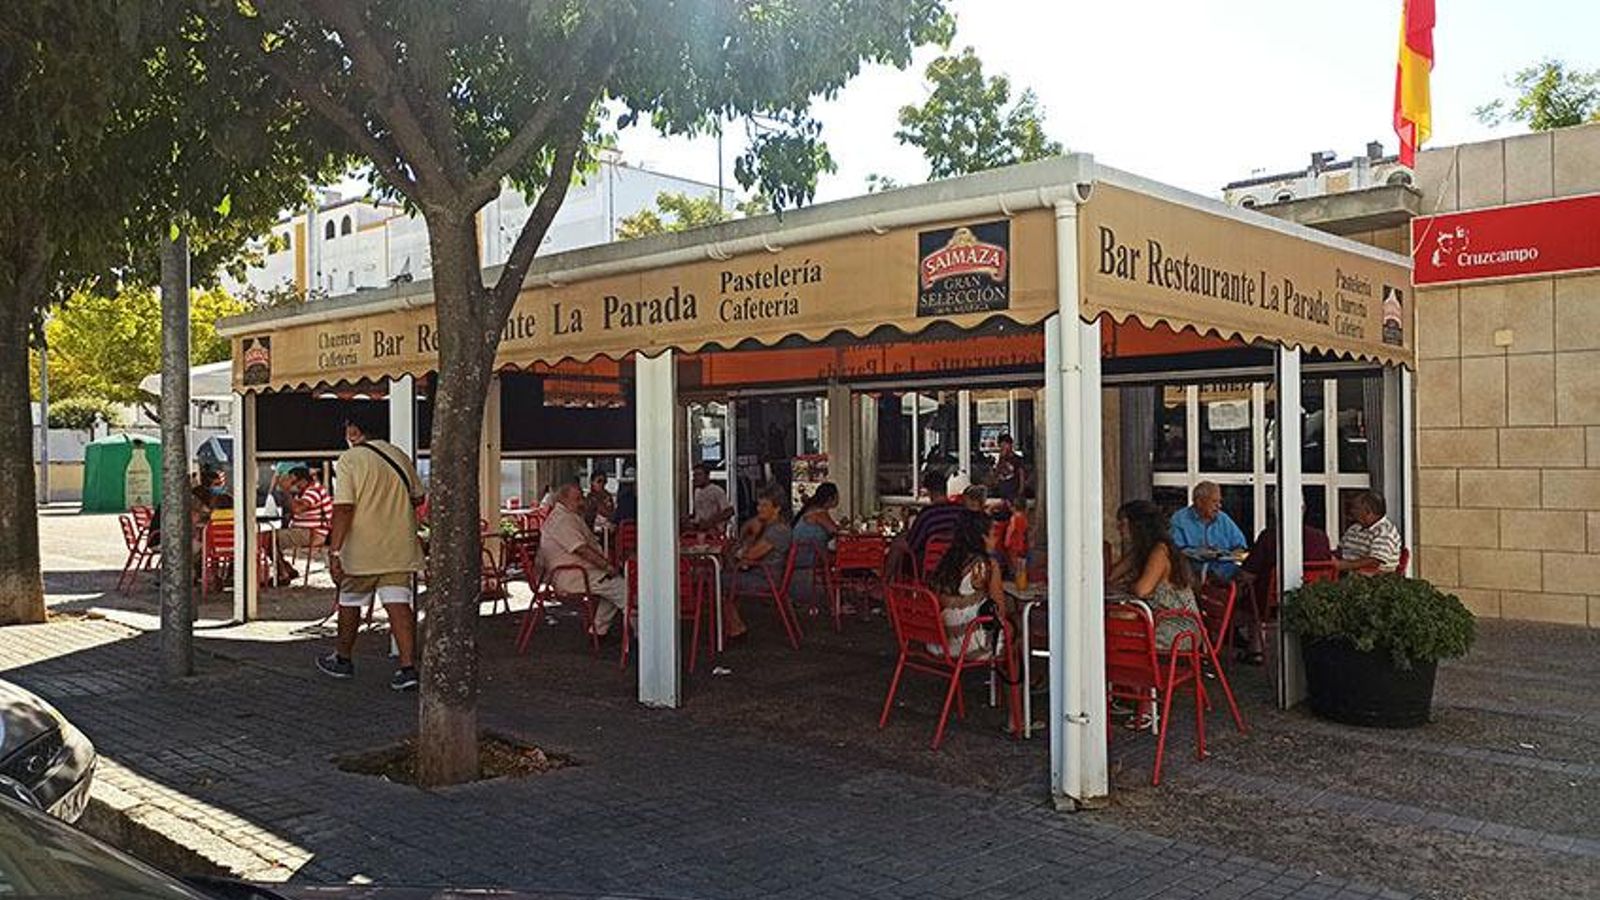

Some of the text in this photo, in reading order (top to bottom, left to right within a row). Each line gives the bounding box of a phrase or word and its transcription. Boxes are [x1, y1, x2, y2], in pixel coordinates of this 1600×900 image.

[925, 248, 1000, 275] SAIMAZA
[1457, 247, 1539, 267] Cruzcampo
[720, 259, 822, 294] Pastelería
[943, 275, 981, 290] GRAN
[1098, 226, 1330, 325] Bar Restaurante La Parada
[720, 292, 799, 322] Cafetería
[921, 283, 1006, 307] SELECCIÓN
[373, 329, 405, 359] Bar
[553, 302, 583, 335] La
[603, 286, 698, 330] Parada
